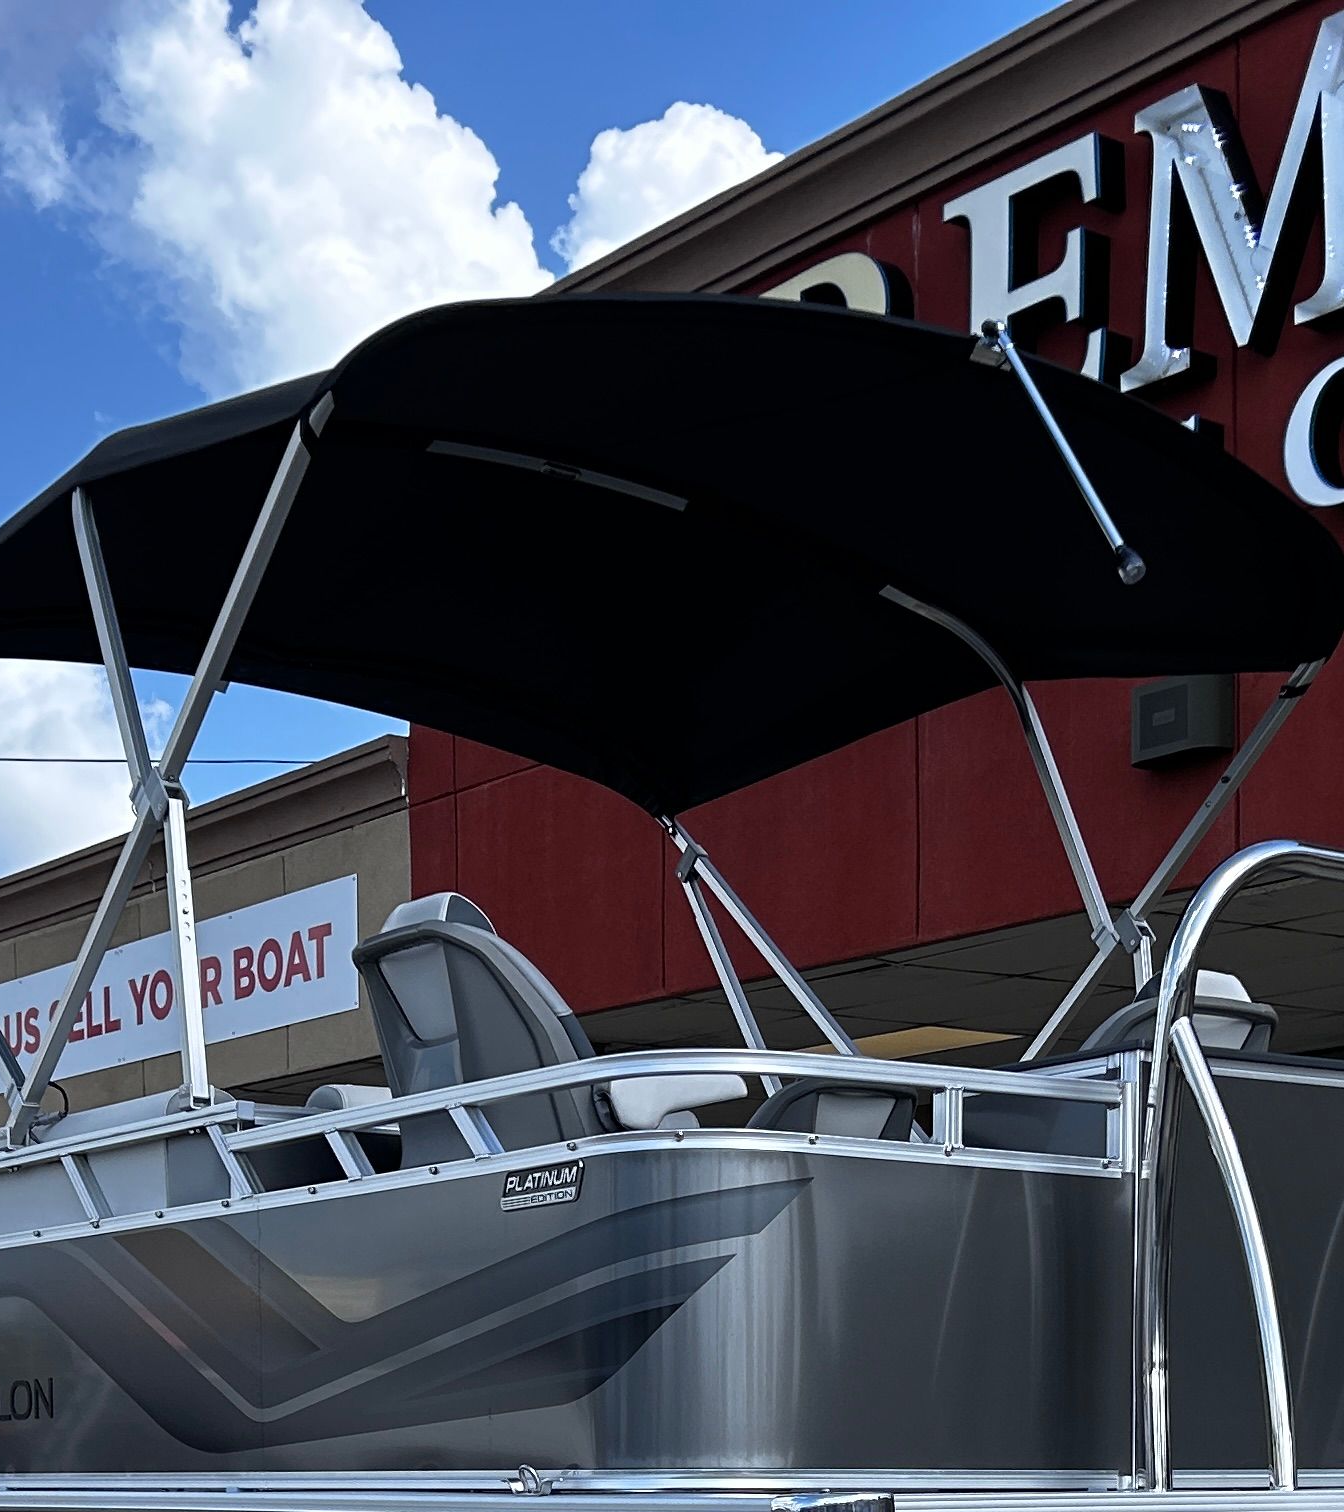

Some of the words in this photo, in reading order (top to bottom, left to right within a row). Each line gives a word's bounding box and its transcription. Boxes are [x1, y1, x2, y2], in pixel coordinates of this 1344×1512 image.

[3, 1006, 41, 1059] US
[127, 956, 223, 1026] YOR
[233, 922, 333, 1000] BOAT
[505, 1165, 578, 1194] PLATINUM
[530, 1188, 574, 1204] EDITION
